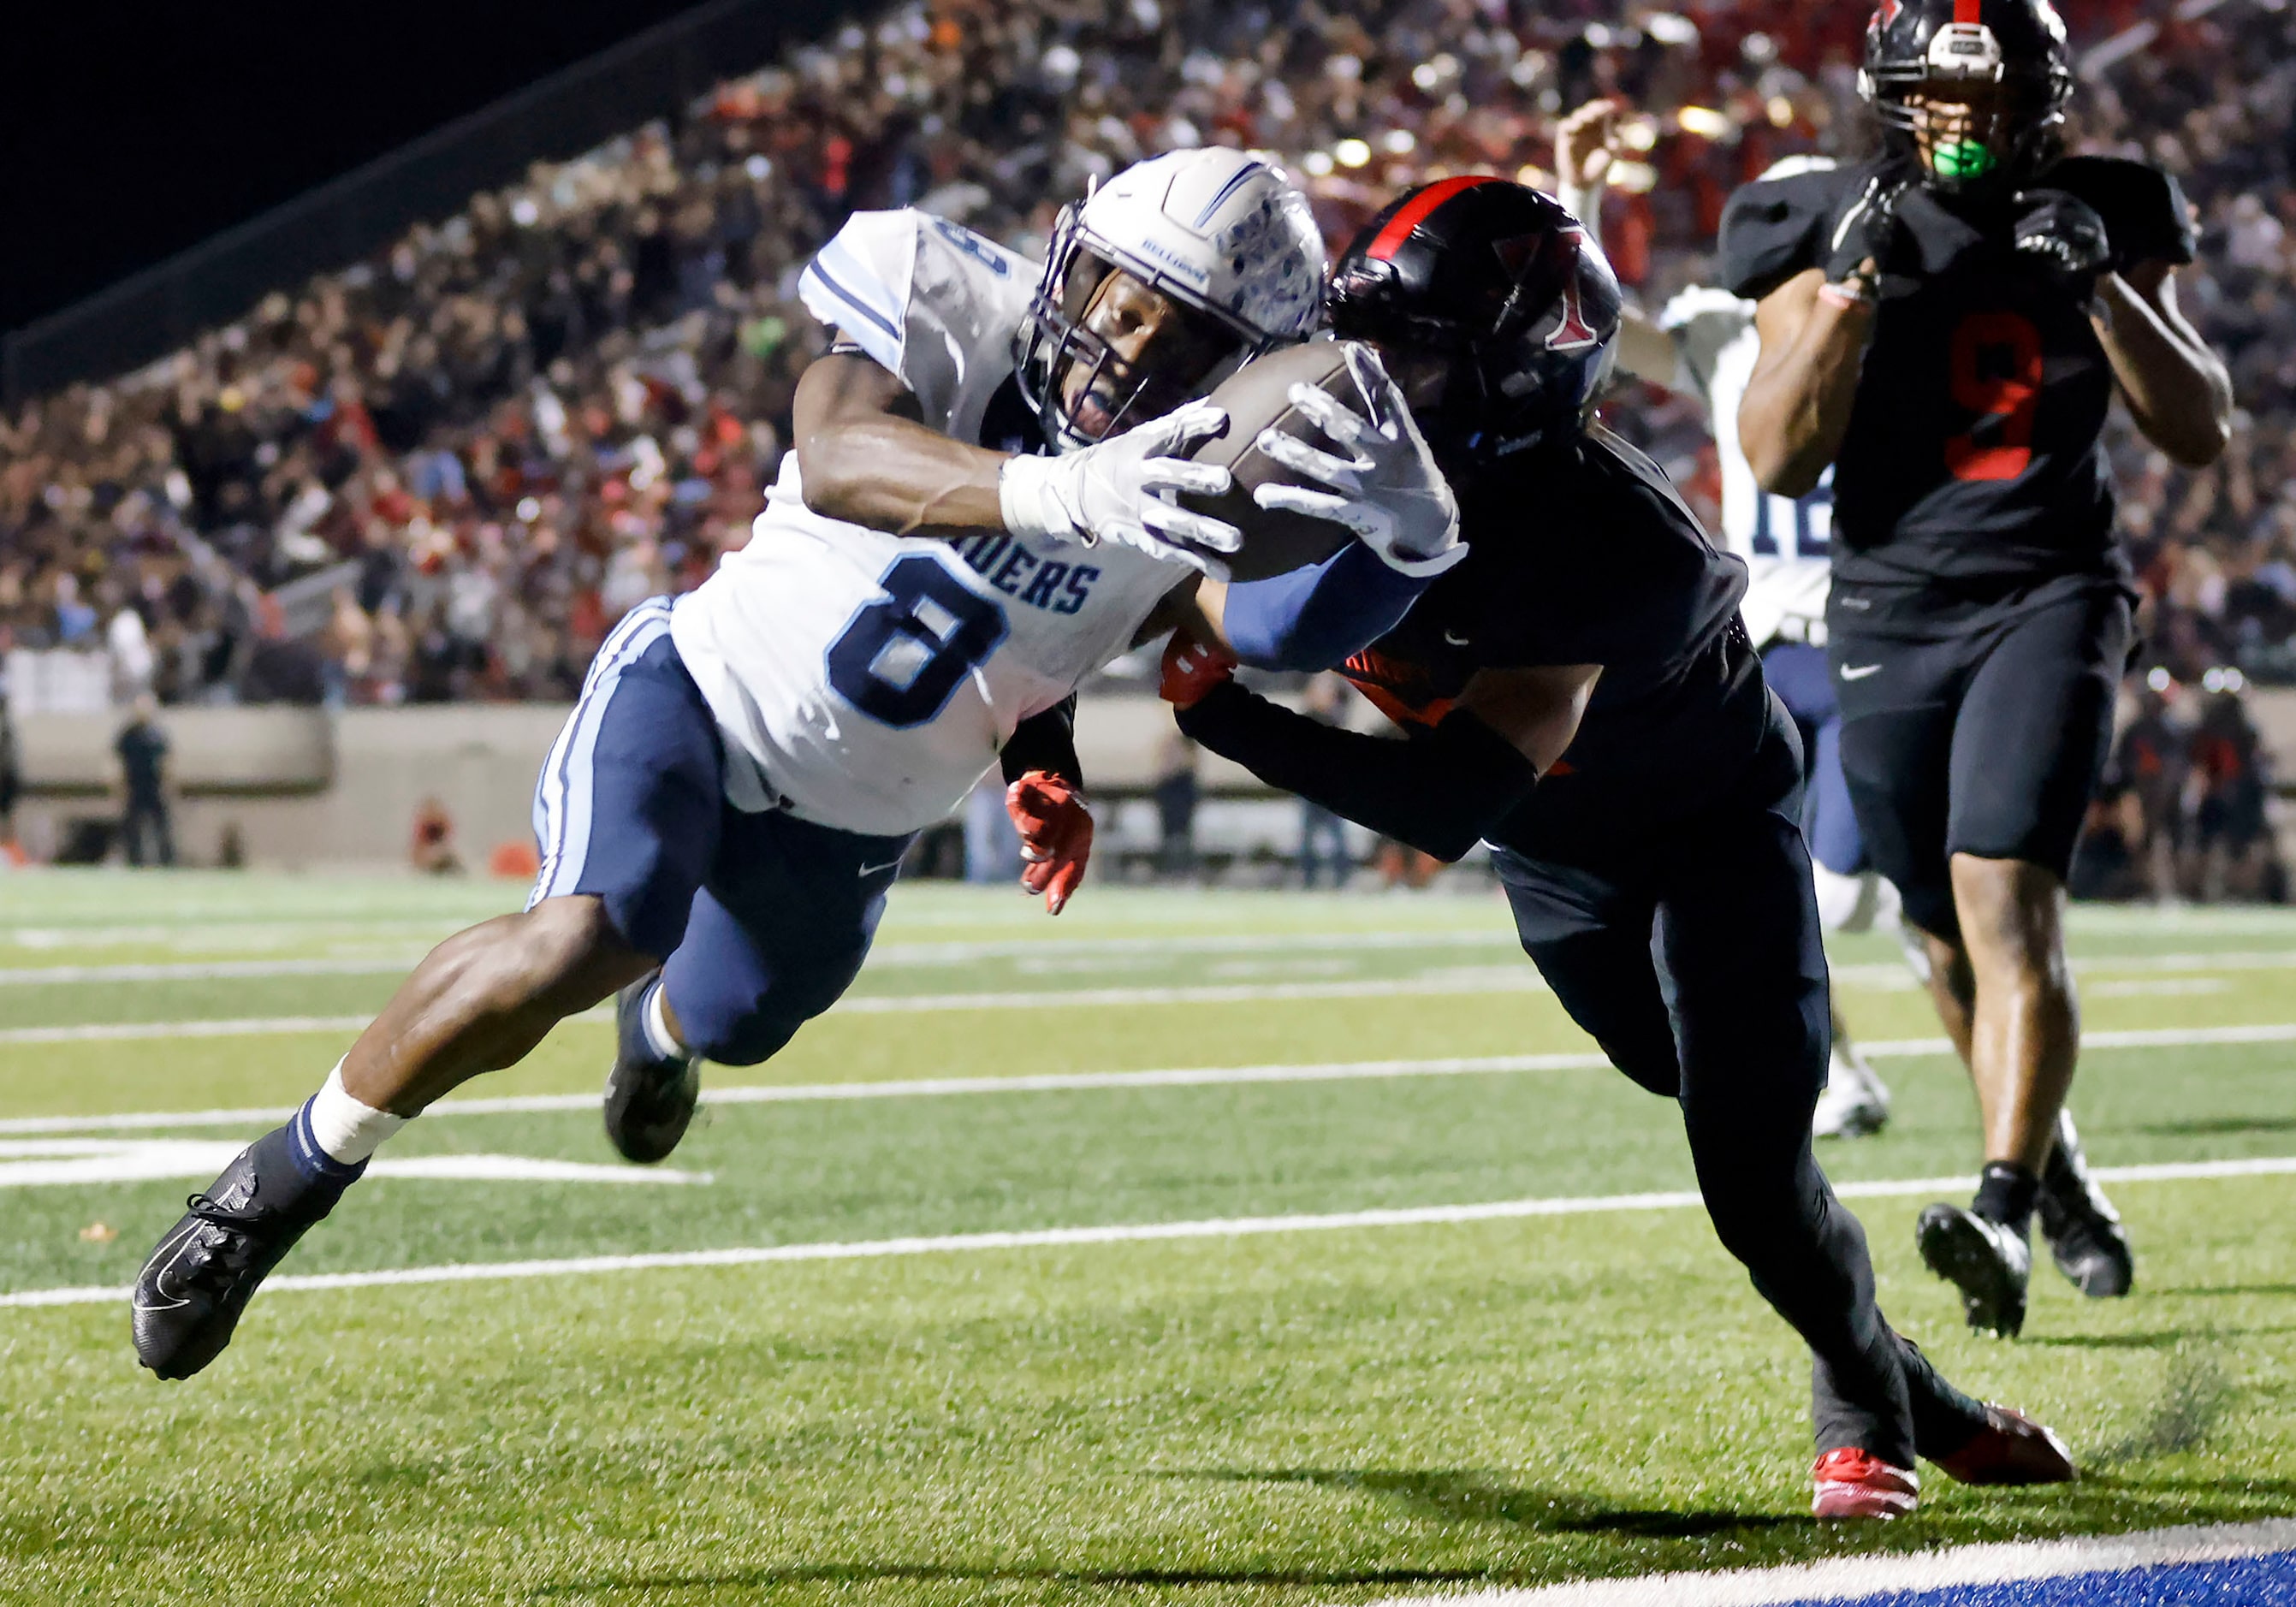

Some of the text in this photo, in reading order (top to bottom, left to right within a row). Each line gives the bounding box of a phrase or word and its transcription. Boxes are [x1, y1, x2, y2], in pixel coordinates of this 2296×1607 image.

[1943, 312, 2044, 481] 9
[822, 550, 1010, 731] 8
[948, 536, 1101, 615] DERS
